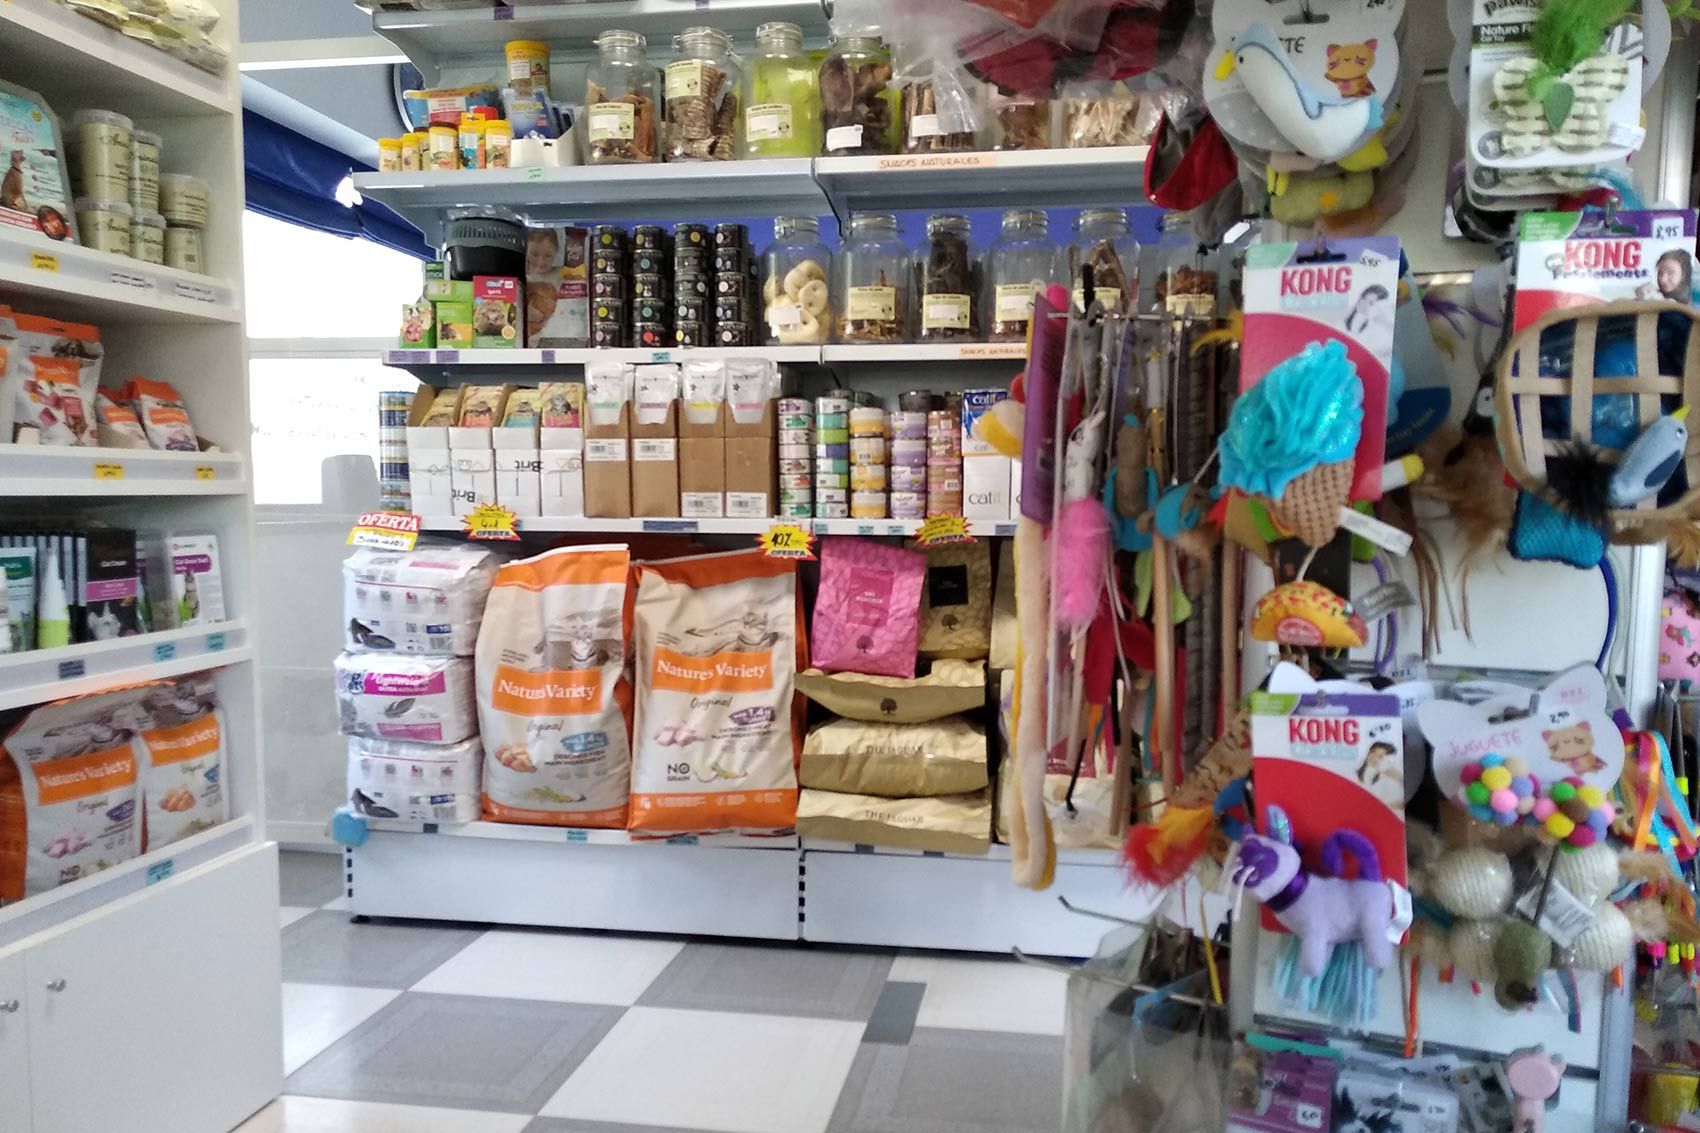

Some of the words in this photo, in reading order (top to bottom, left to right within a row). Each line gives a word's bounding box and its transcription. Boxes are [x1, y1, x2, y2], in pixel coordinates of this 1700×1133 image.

[1480, 25, 1519, 36] Nature
[921, 156, 980, 167] NATURALES
[1563, 239, 1642, 271] KONG
[1280, 265, 1353, 296] KONG
[358, 513, 418, 531] OFERTA
[715, 662, 768, 679] Variety
[1289, 718, 1360, 746] KONG
[1448, 729, 1523, 758] JUGUETE
[667, 762, 690, 775] NO
